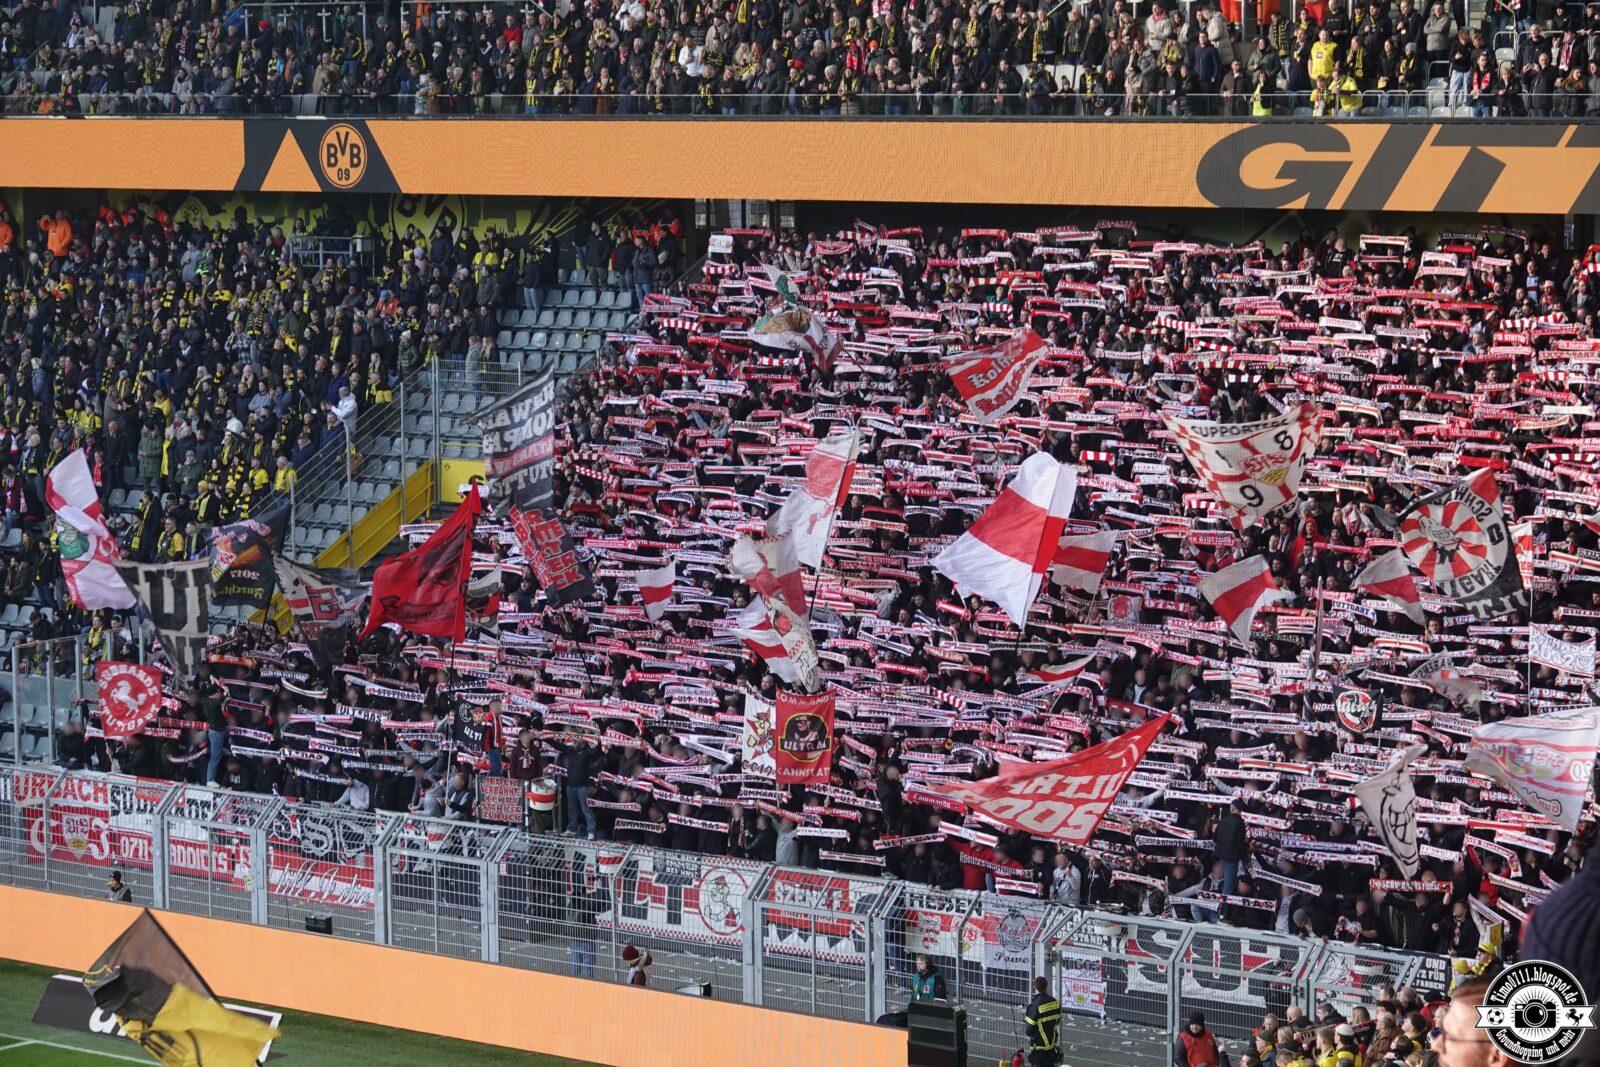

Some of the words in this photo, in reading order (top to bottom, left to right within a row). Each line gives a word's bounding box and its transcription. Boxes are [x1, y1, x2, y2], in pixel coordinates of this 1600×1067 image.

[326, 131, 362, 168] BVB
[337, 168, 351, 181] 09
[1191, 419, 1288, 437] SUPPORTERS
[1276, 430, 1294, 451] 8
[1240, 485, 1263, 507] 9
[14, 772, 109, 805] URBACH
[120, 835, 148, 861] 0711
[1425, 957, 1447, 970] UND
[1428, 968, 1446, 982] FÜR
